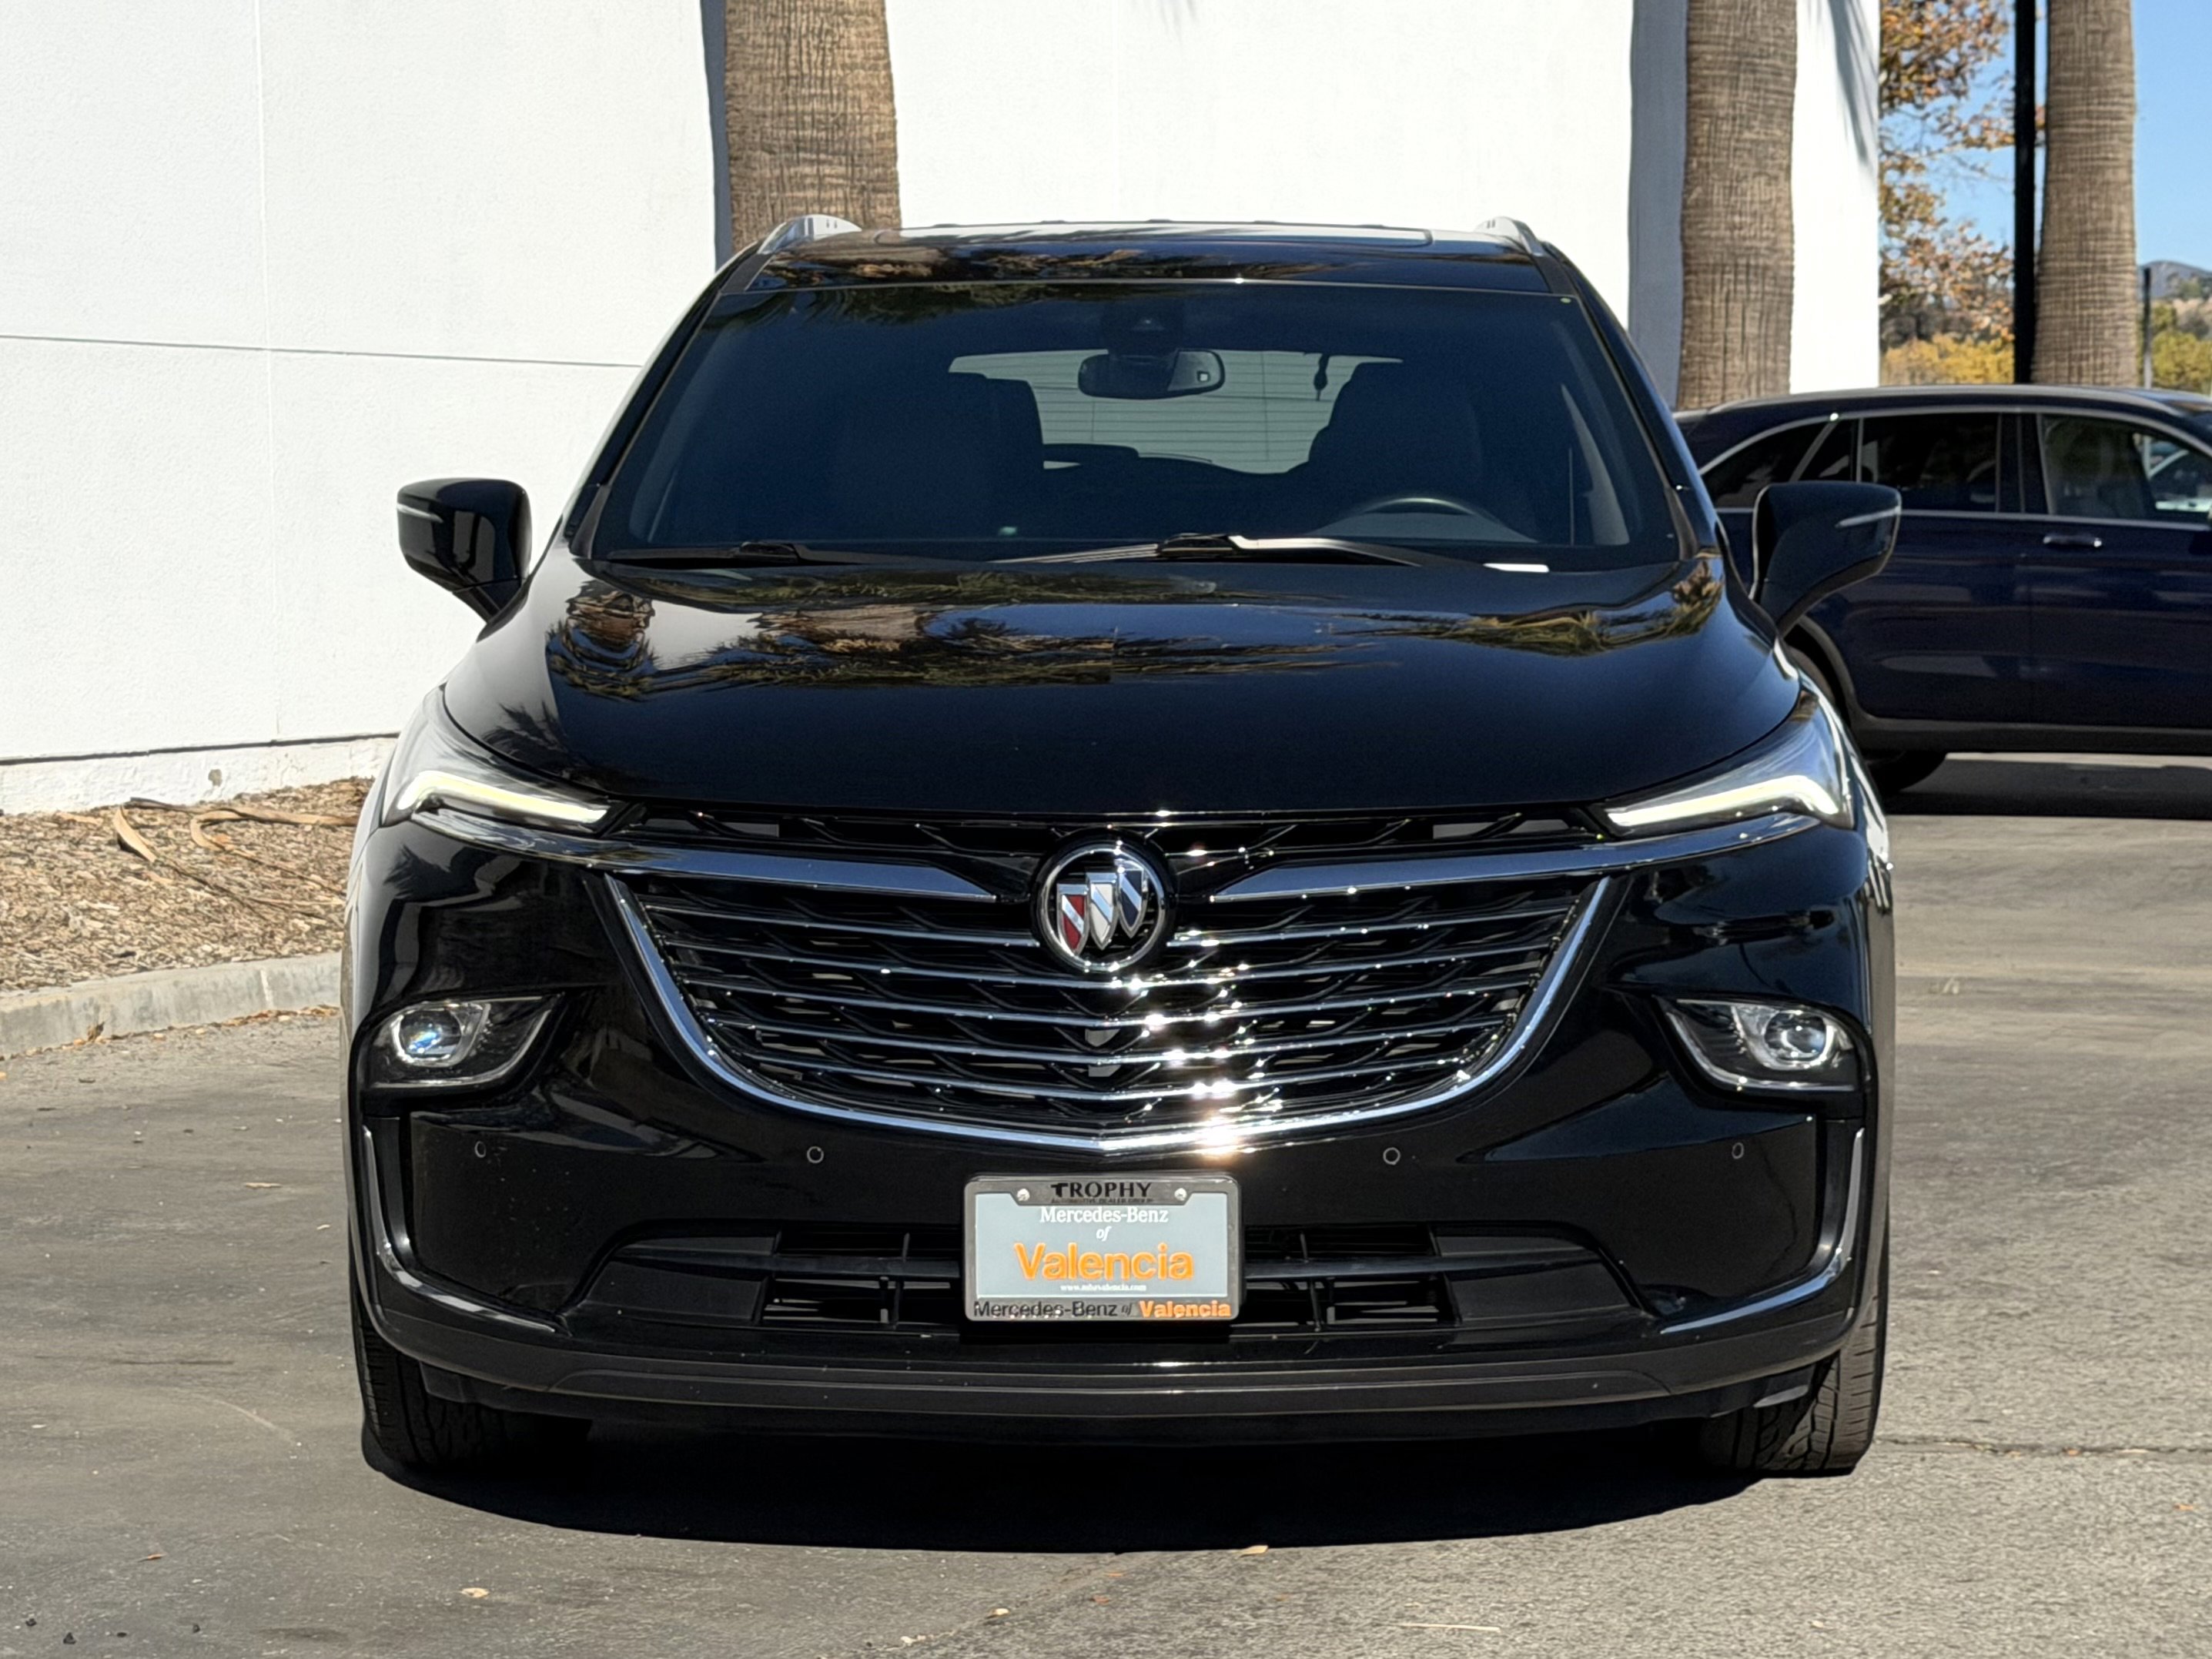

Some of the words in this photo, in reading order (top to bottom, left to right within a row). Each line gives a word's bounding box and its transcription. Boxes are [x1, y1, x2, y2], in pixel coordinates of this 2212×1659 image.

[1050, 1182, 1153, 1198] TROPHY
[1039, 1206, 1169, 1223] Mercedes-Benz
[1096, 1226, 1112, 1241] of
[1014, 1242, 1194, 1280] Valencia
[974, 1300, 1117, 1316] Mercedes-Benz
[1121, 1302, 1133, 1316] of
[1139, 1299, 1231, 1317] Valencia
